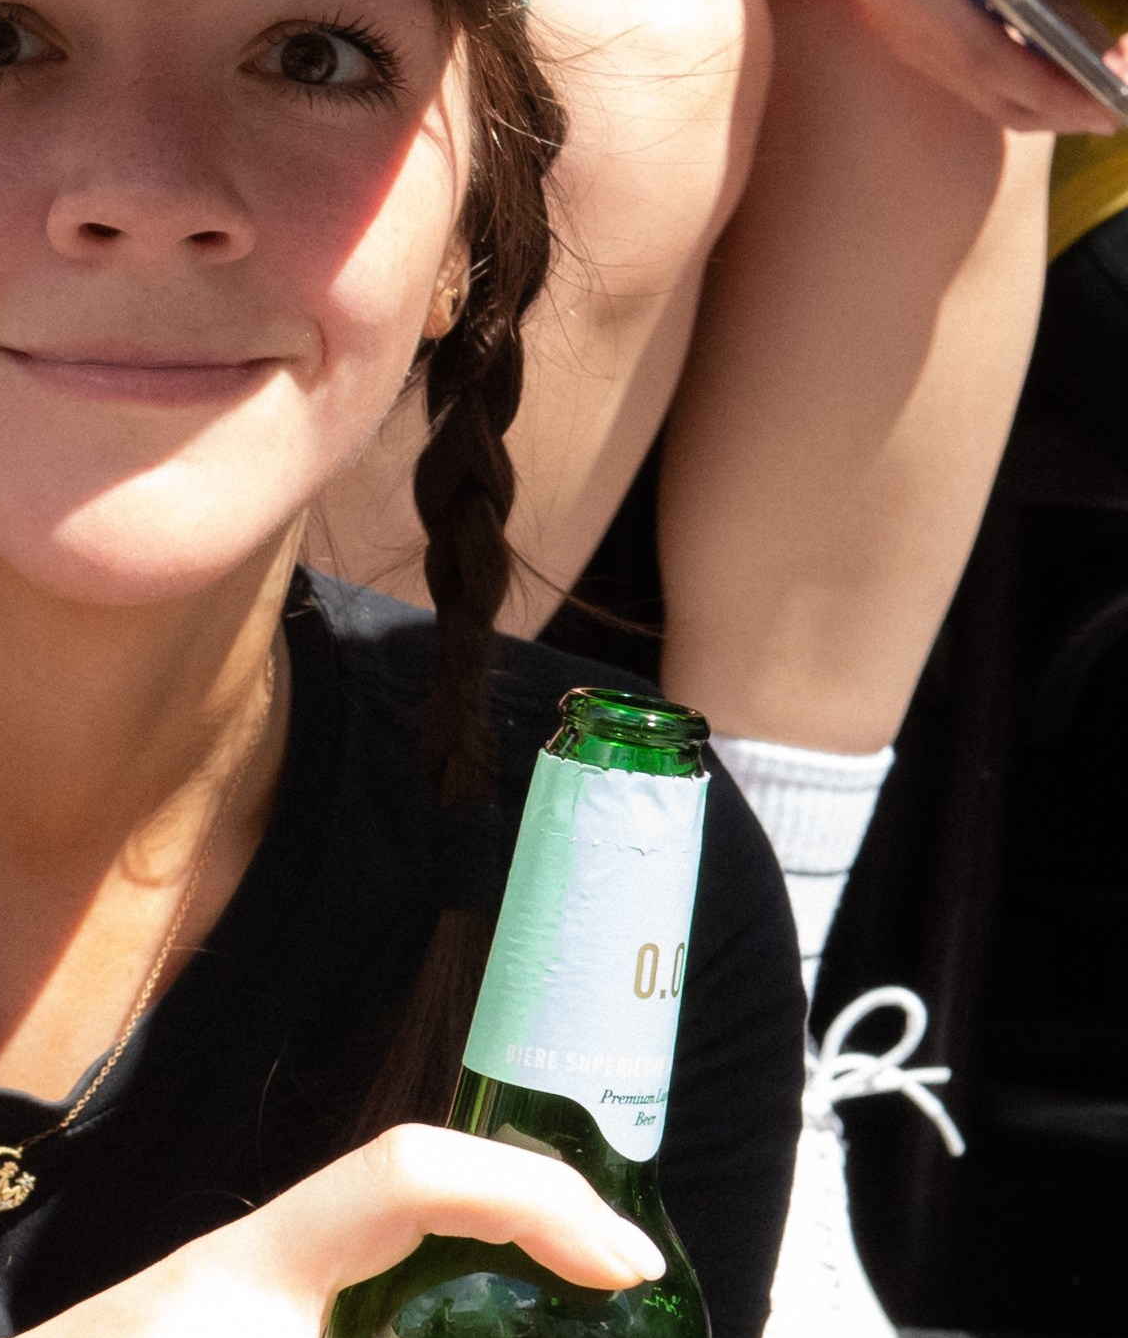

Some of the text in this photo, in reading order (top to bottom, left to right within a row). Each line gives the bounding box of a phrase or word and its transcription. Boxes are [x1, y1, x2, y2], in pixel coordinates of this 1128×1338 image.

[634, 942, 685, 999] 0.0
[600, 1088, 655, 1105] Premium
[634, 1111, 657, 1127] Beer
